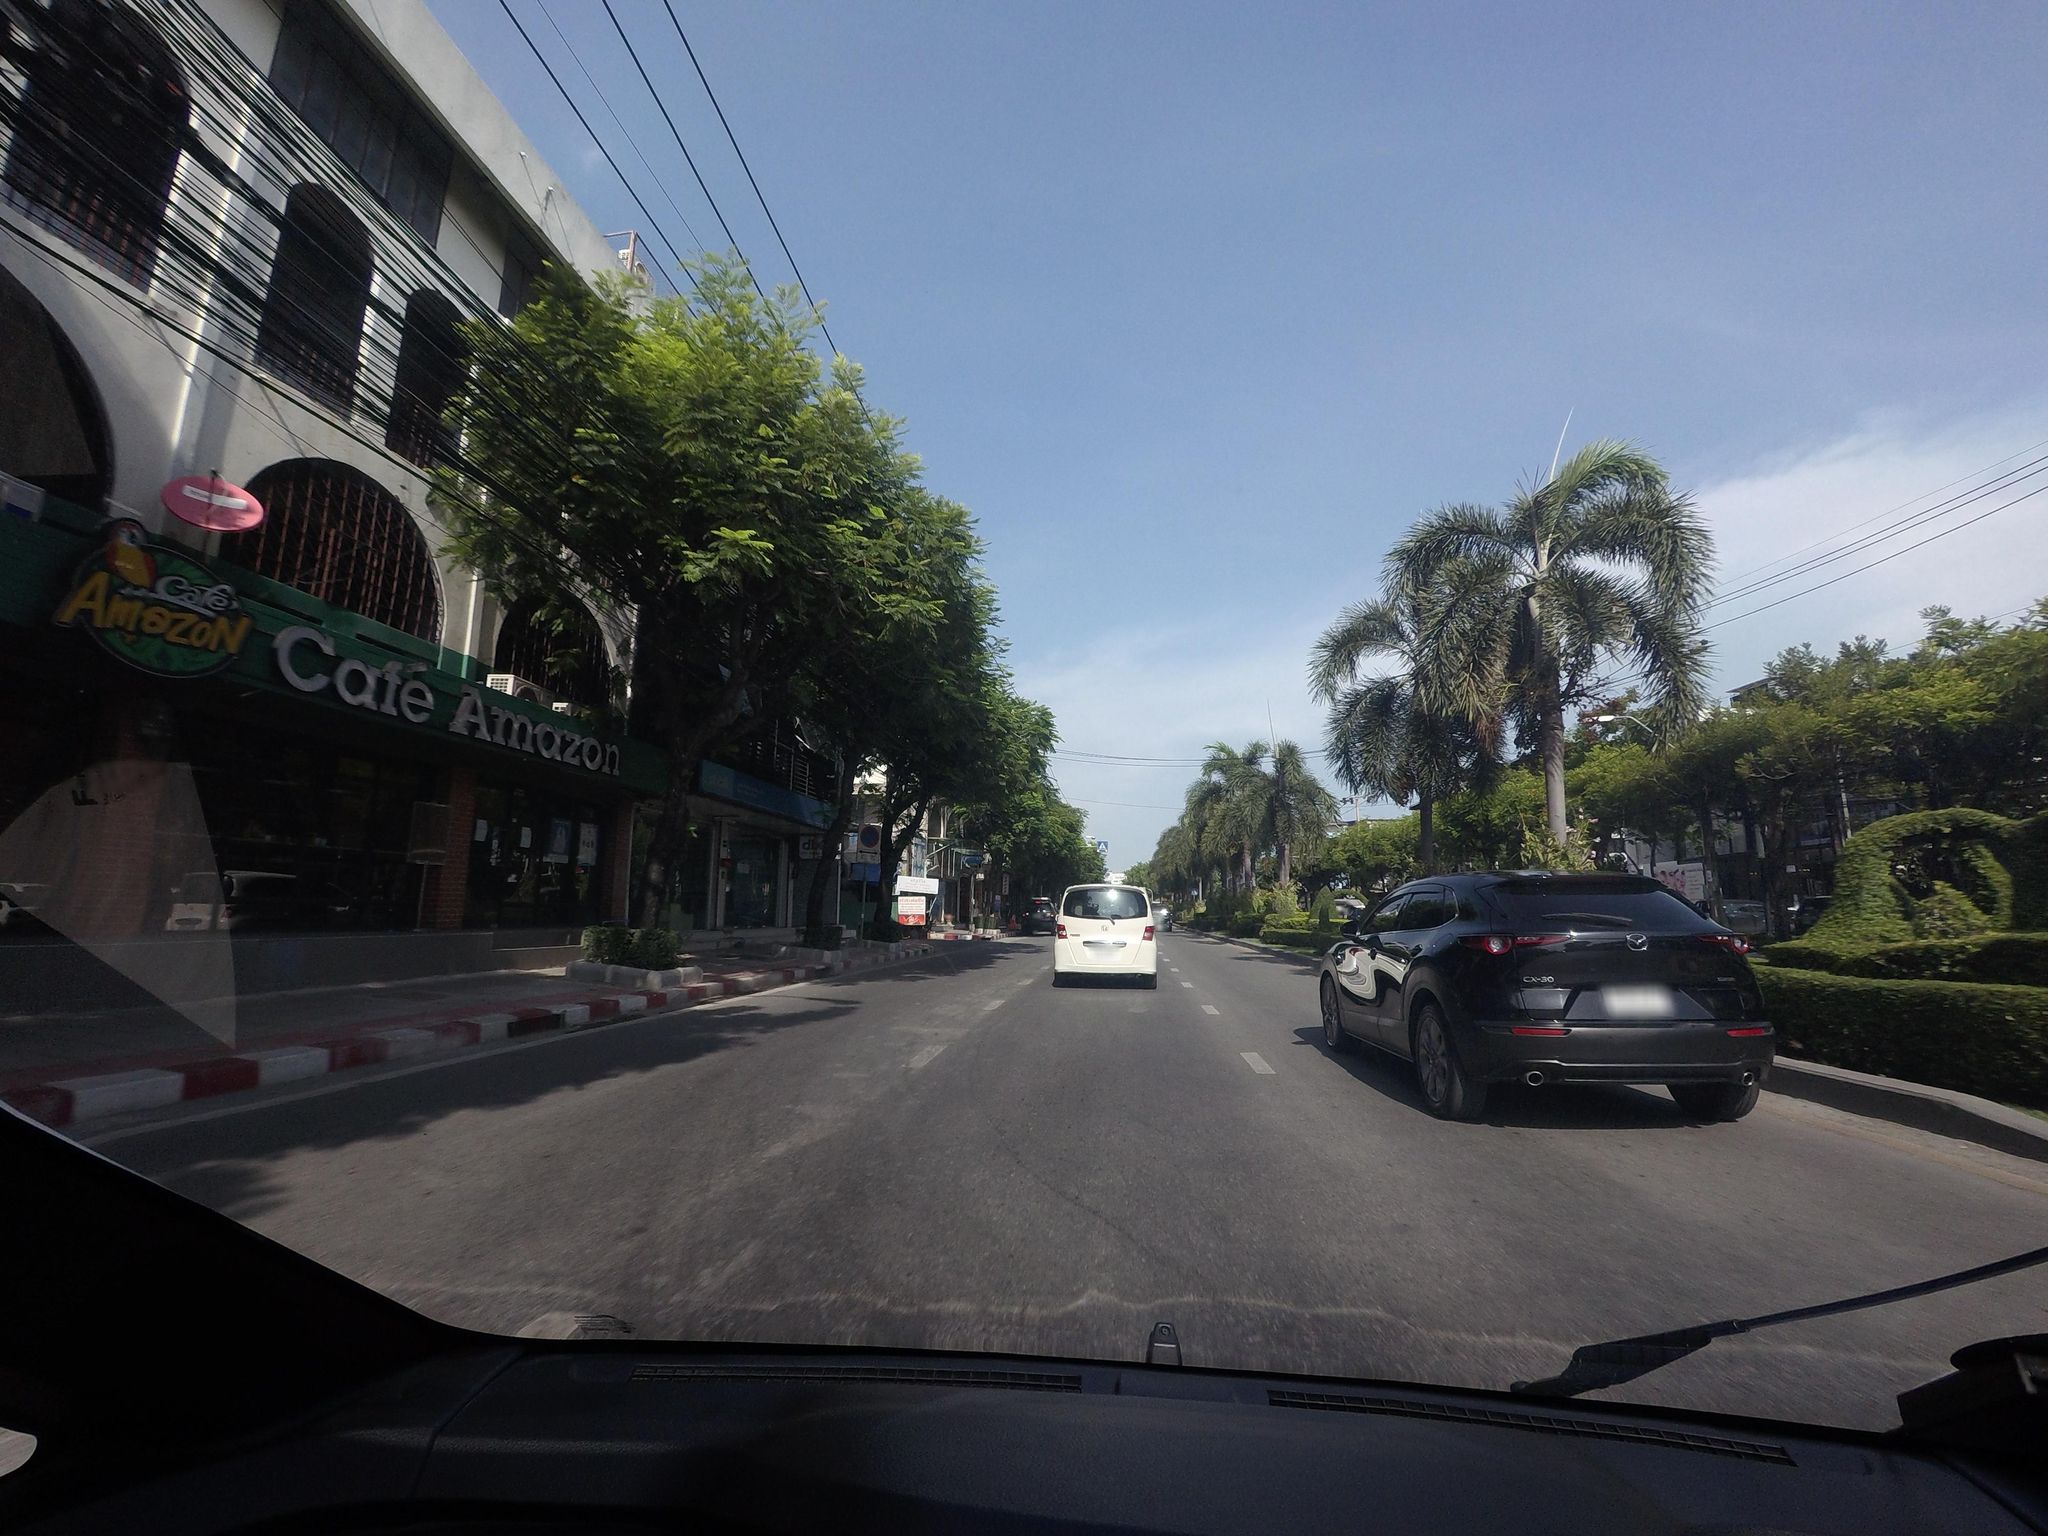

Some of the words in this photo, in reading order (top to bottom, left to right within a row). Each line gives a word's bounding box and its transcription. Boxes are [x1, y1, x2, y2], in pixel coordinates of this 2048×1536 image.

[154, 575, 241, 613] Café
[273, 625, 434, 724] Café
[449, 684, 620, 775] Amazon
[1522, 976, 1554, 984] CX-30
